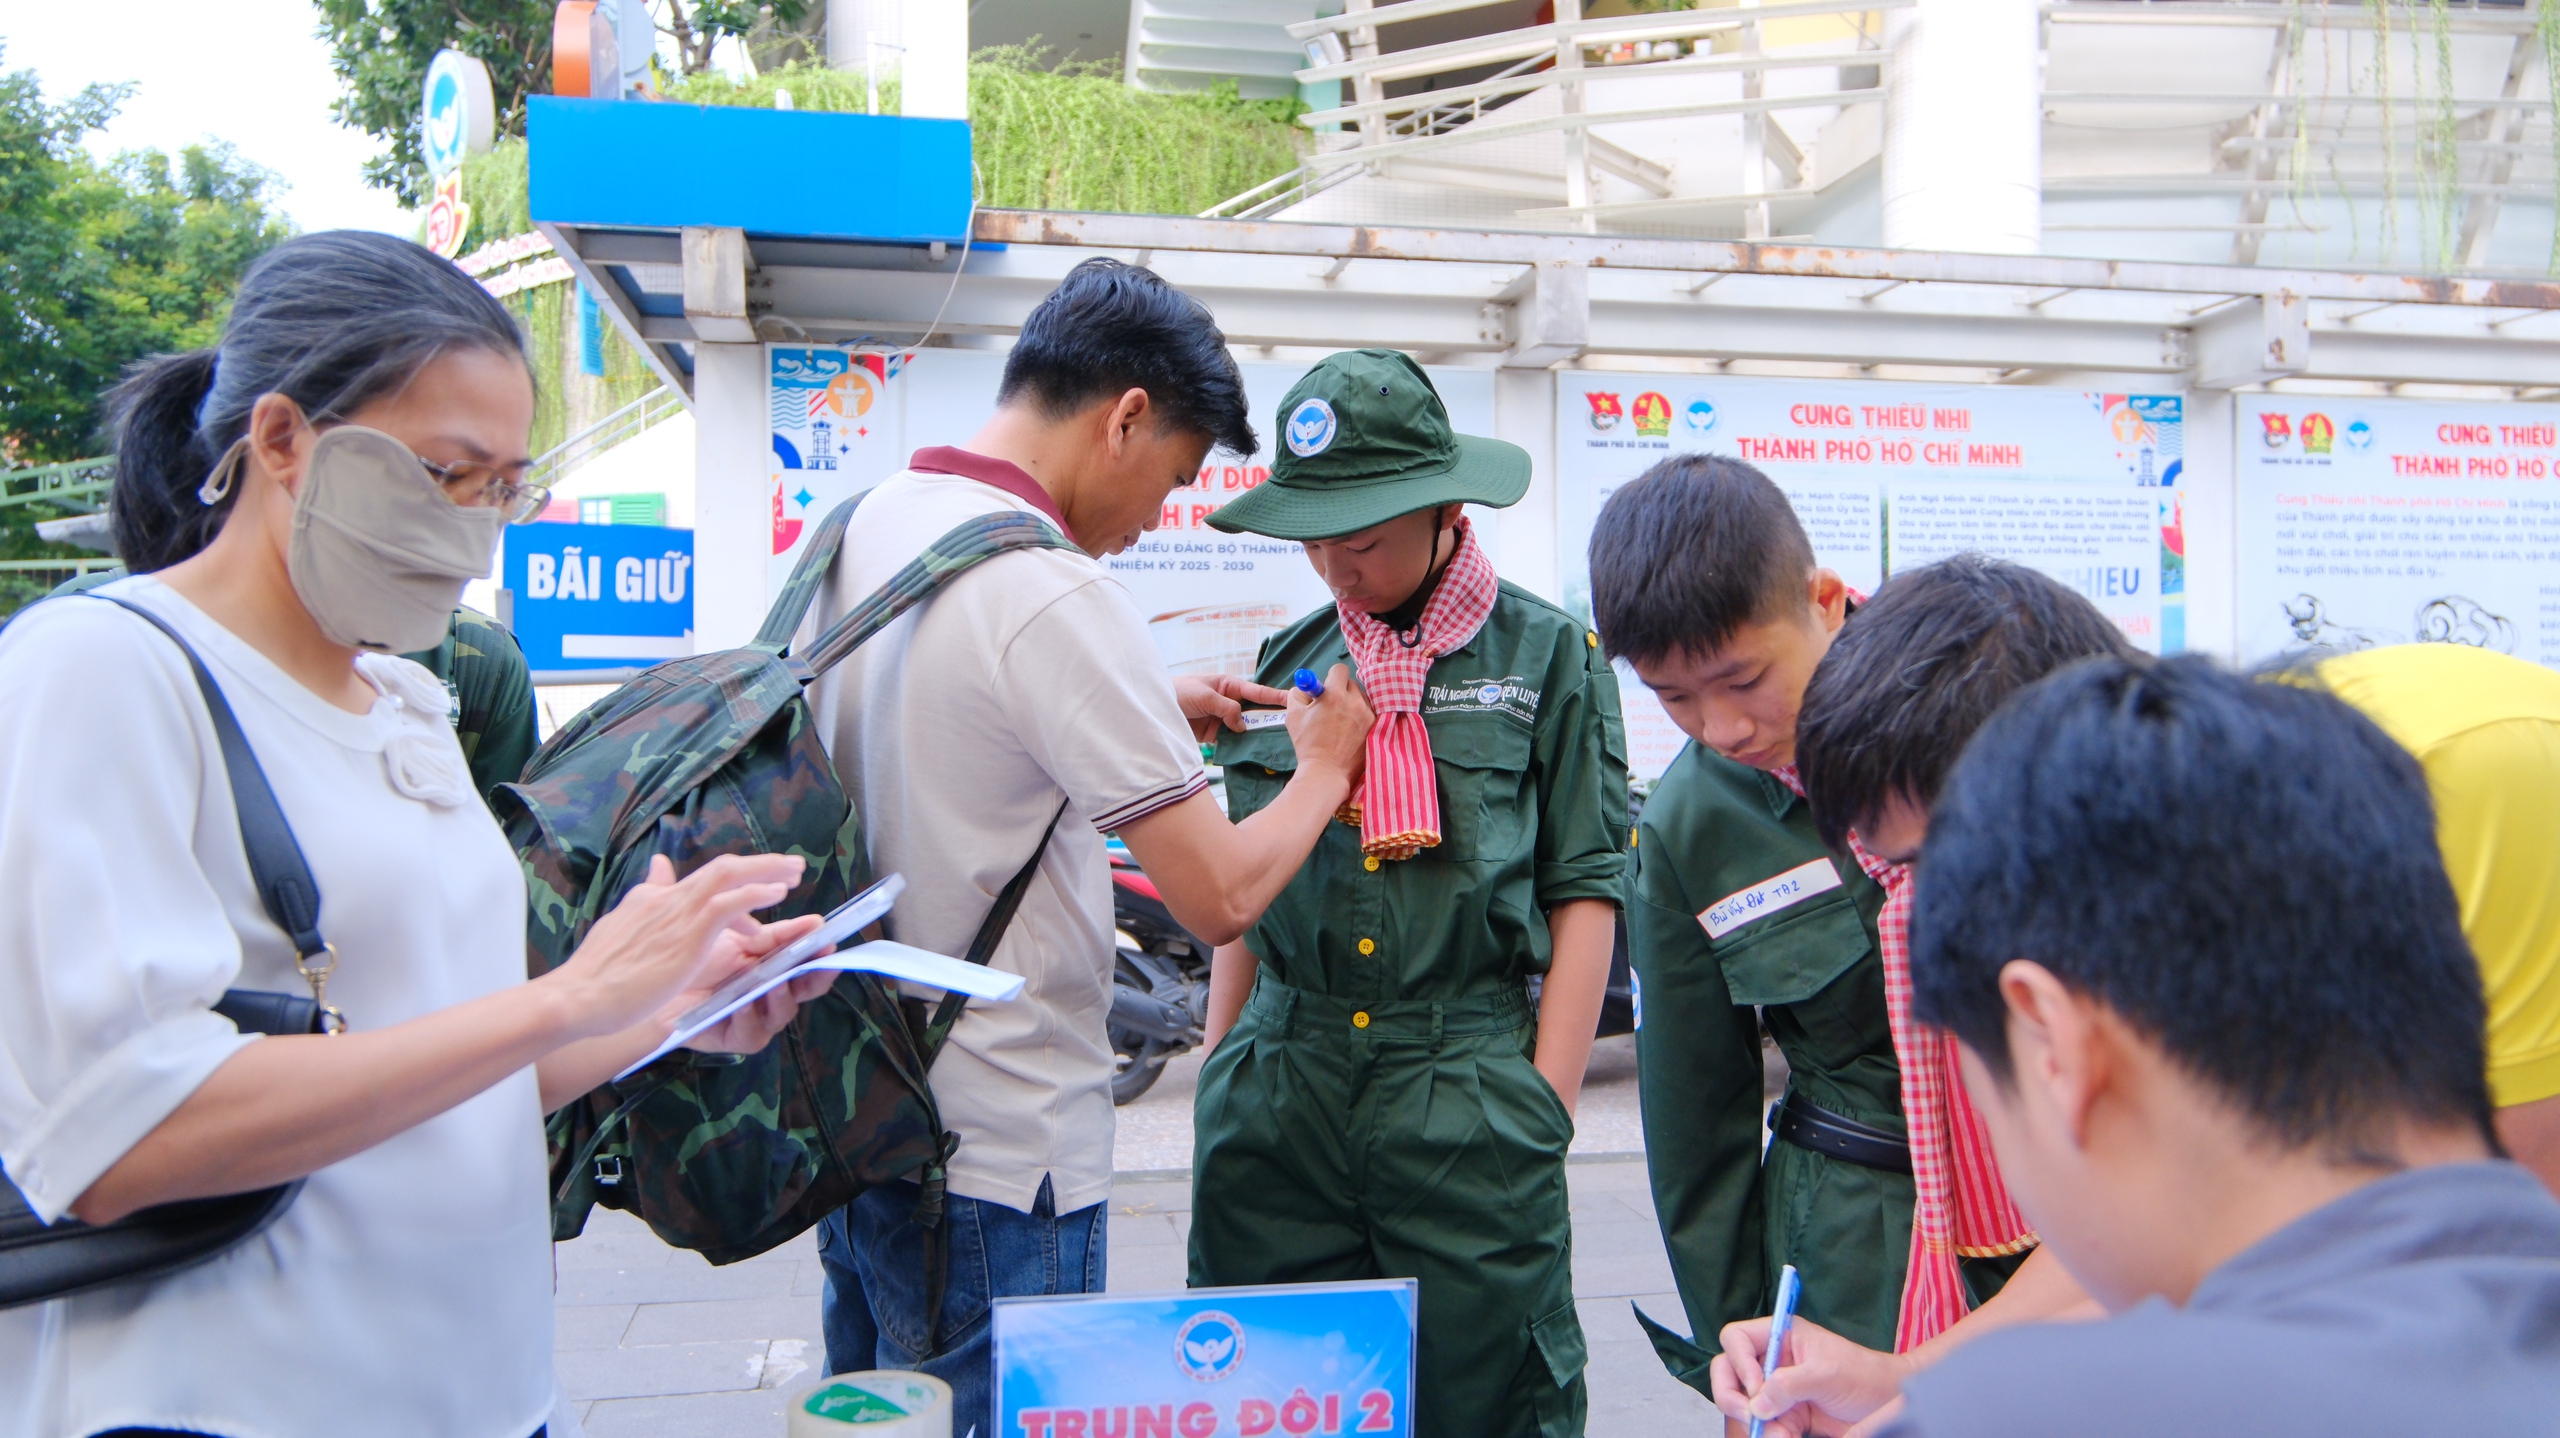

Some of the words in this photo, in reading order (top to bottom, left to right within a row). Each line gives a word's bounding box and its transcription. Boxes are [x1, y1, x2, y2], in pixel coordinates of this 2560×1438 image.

[1790, 403, 1853, 428] CUNG
[1934, 408, 1971, 431] NHI
[1737, 432, 1817, 461] THÀNH
[2437, 423, 2492, 446] CUNG
[2391, 449, 2461, 478] THÀNH
[1138, 541, 1170, 554] BIỂU
[1174, 540, 1213, 554] ĐẢNG
[1217, 541, 1236, 558] BỘ
[1242, 541, 1288, 554] THÀNH
[527, 545, 601, 602] BÃI
[615, 550, 691, 604] GIỮ
[1110, 557, 1154, 573] NHIỆM
[1180, 560, 1210, 571] 2025
[1223, 560, 1254, 571] 2030
[1518, 687, 1541, 711] LUYỆ
[1018, 1400, 1218, 1438] TRUNG
[1236, 1387, 1340, 1438] ĐỘI
[1356, 1388, 1393, 1433] 2
